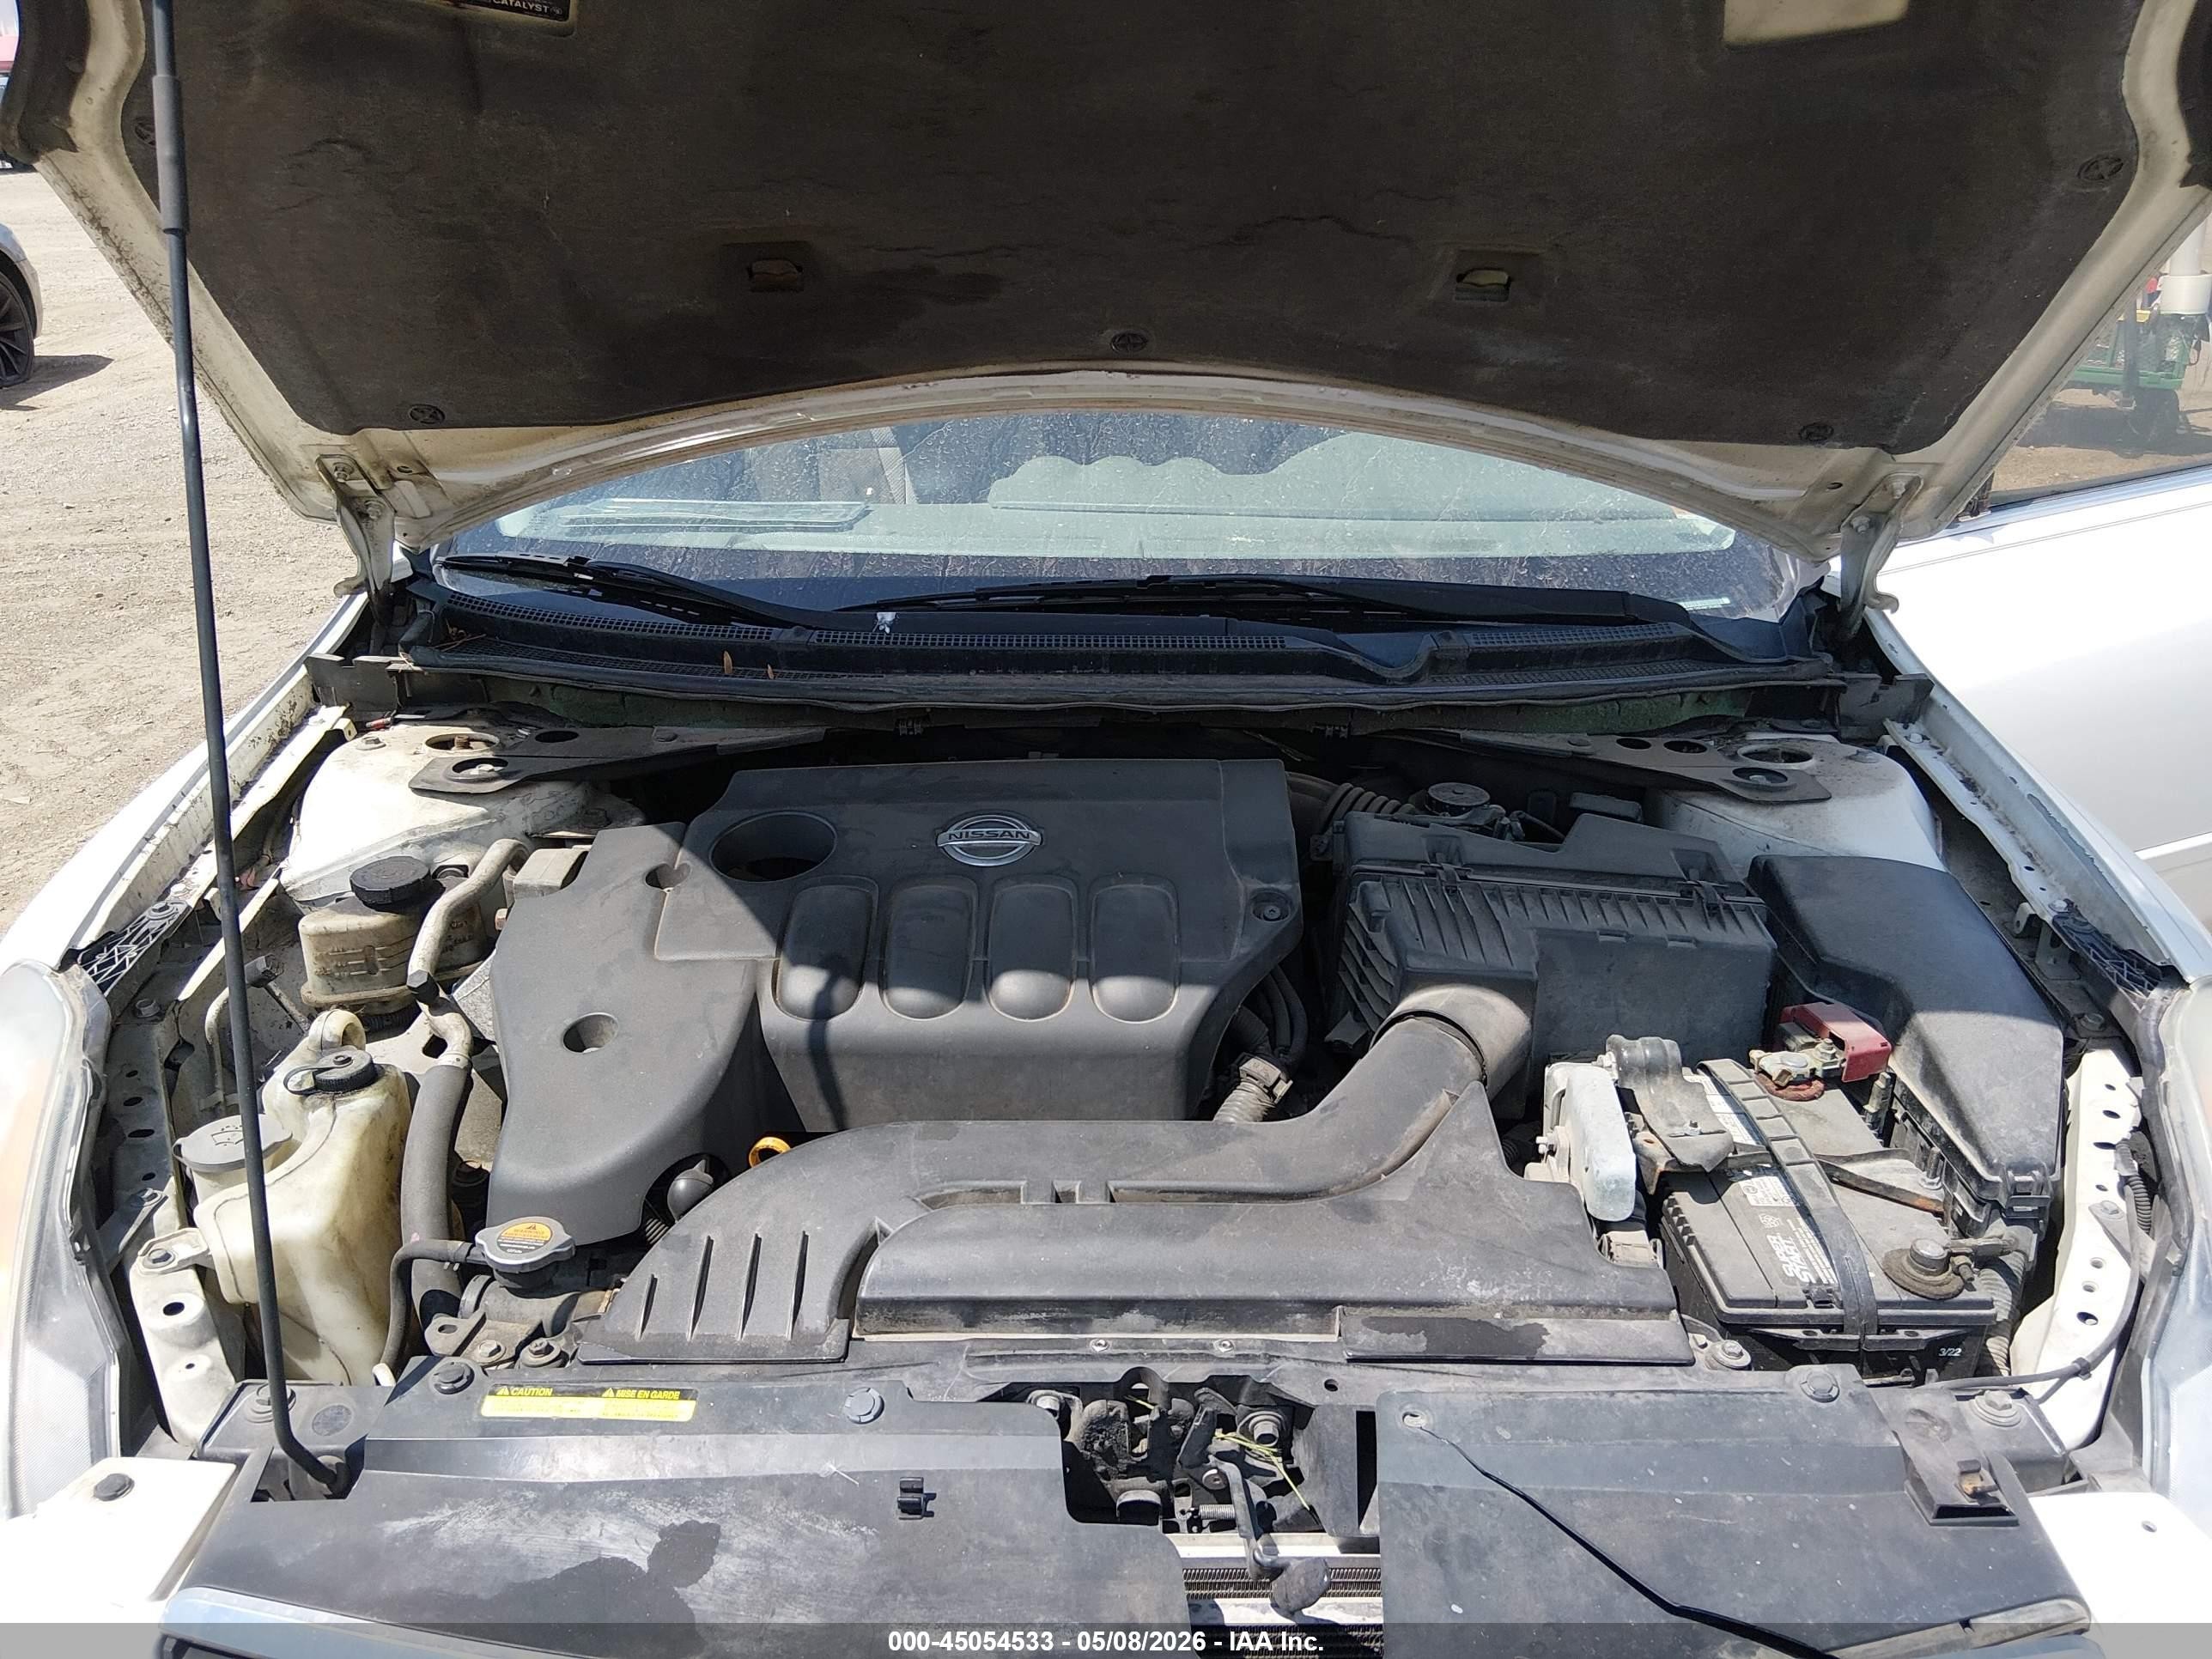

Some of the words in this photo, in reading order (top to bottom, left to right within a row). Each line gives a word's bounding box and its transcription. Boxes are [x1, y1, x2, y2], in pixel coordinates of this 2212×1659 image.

[948, 830, 1030, 840] NISSAN
[1766, 1232, 1796, 1277] SUPER
[1779, 1236, 1817, 1284] START
[1938, 1347, 1963, 1357] 3/22
[510, 1386, 554, 1396] CAUTION
[616, 1389, 637, 1398] MISE
[636, 1389, 651, 1399] EN
[650, 1390, 681, 1400] GARDE
